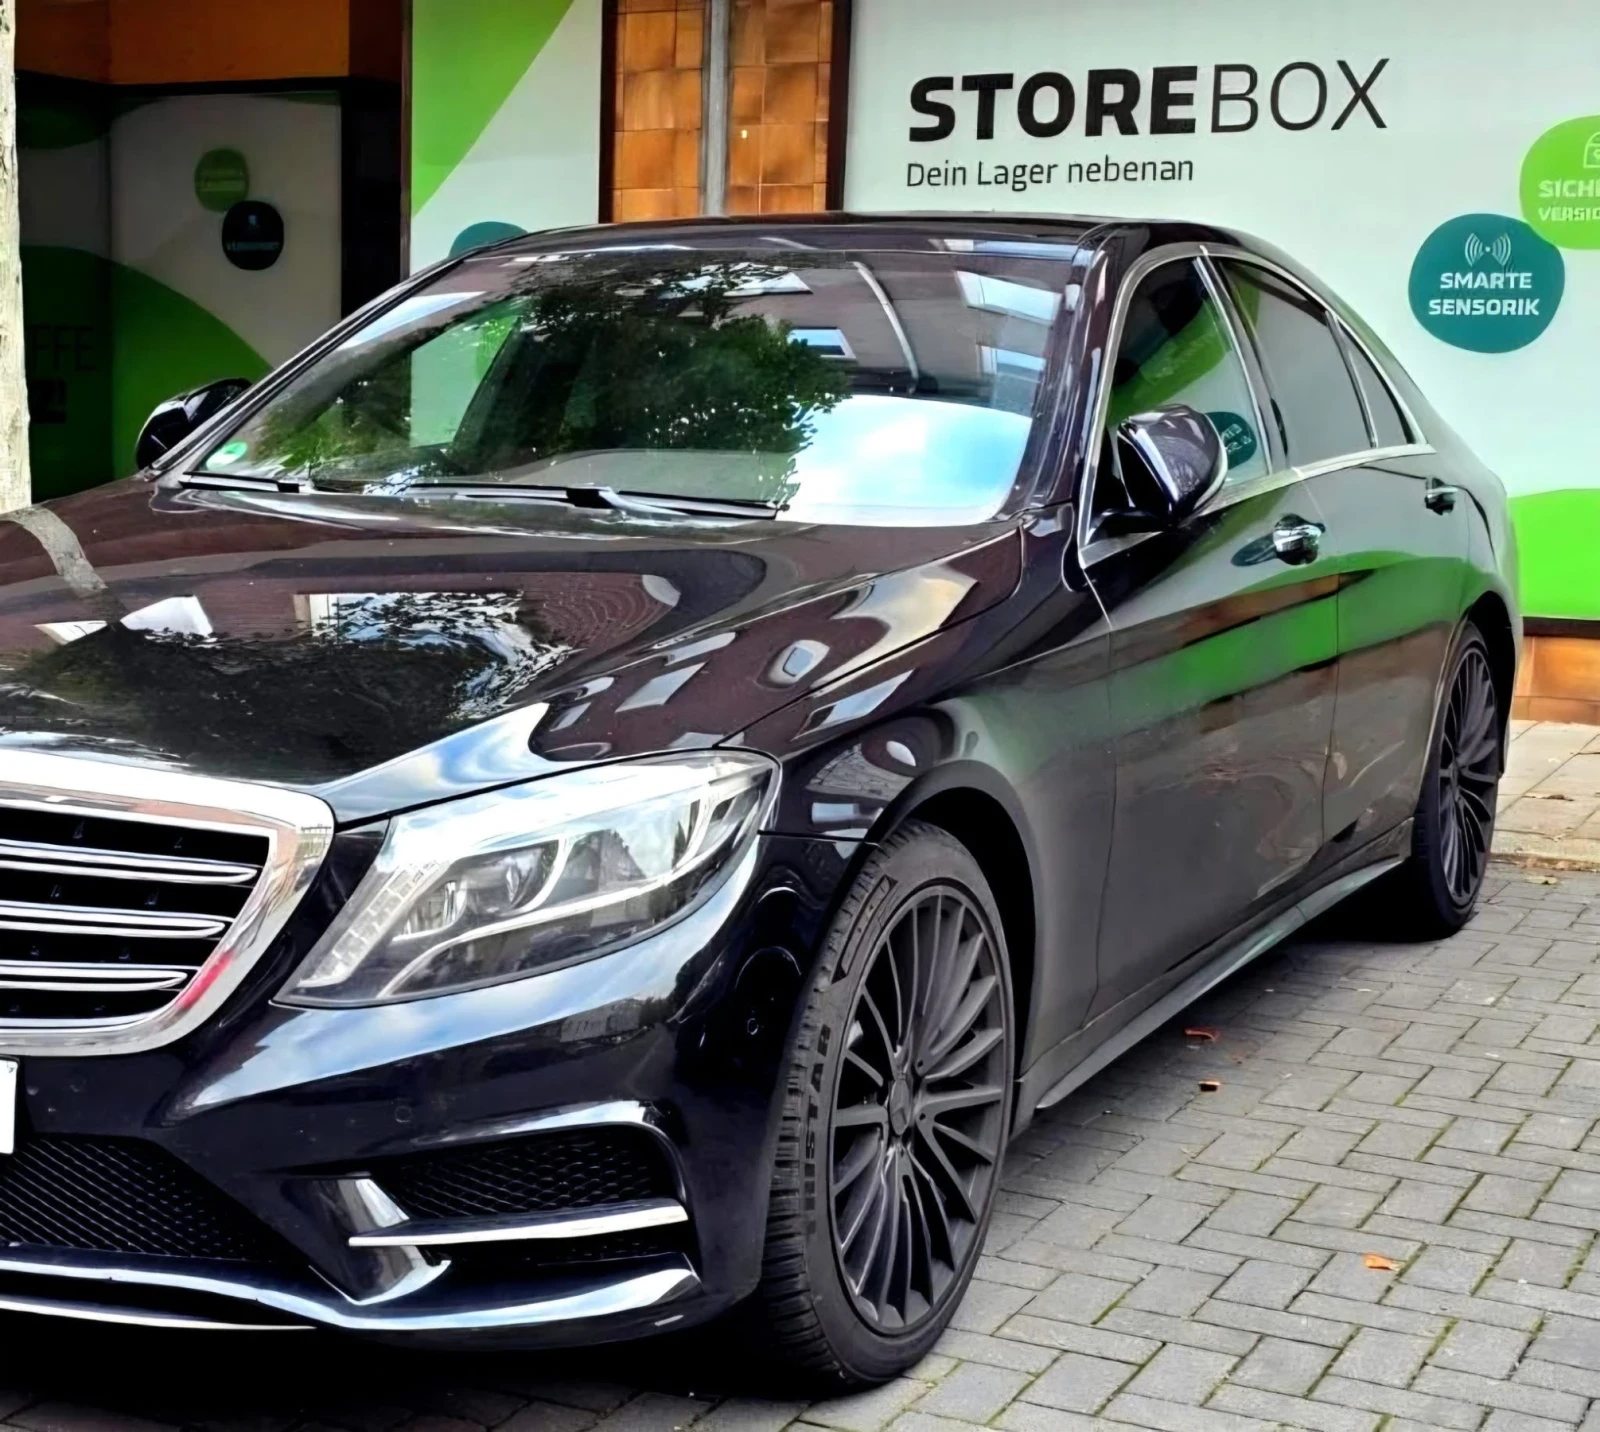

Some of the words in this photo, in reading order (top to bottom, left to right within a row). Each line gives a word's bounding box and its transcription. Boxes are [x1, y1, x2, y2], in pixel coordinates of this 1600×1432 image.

[909, 58, 1390, 142] STOREBOX
[906, 160, 967, 187] Dein
[977, 161, 1058, 192] Lager
[1068, 155, 1193, 183] nebenan
[1440, 271, 1532, 289] SMARTE
[1428, 298, 1540, 316] SENSORIK
